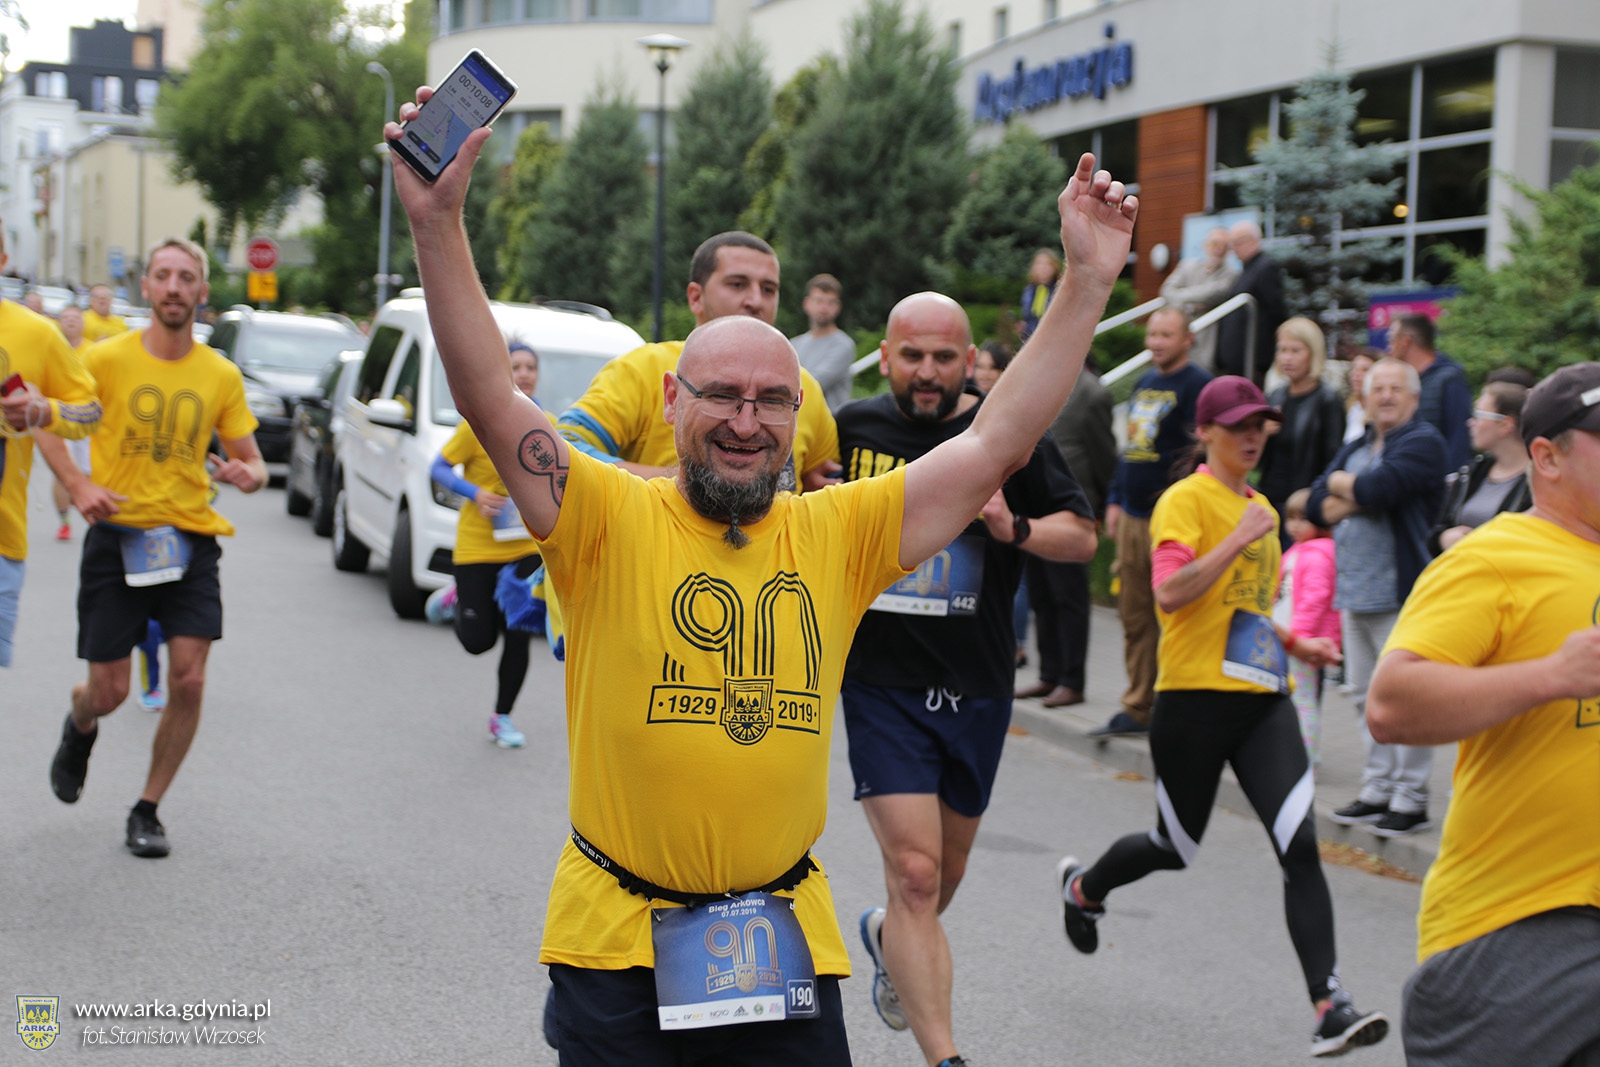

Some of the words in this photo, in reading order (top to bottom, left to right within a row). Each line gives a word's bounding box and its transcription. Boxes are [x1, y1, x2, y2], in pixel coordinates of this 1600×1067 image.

[458, 74, 493, 109] 00:10:08
[952, 596, 976, 611] 442
[671, 570, 822, 690] 90
[668, 694, 717, 715] 1929
[778, 700, 813, 723] 2019
[731, 714, 764, 722] ARKA
[708, 904, 729, 914] Bieg
[721, 907, 757, 918] 07.07.2019
[704, 916, 779, 970] 90
[789, 986, 813, 1007] 190
